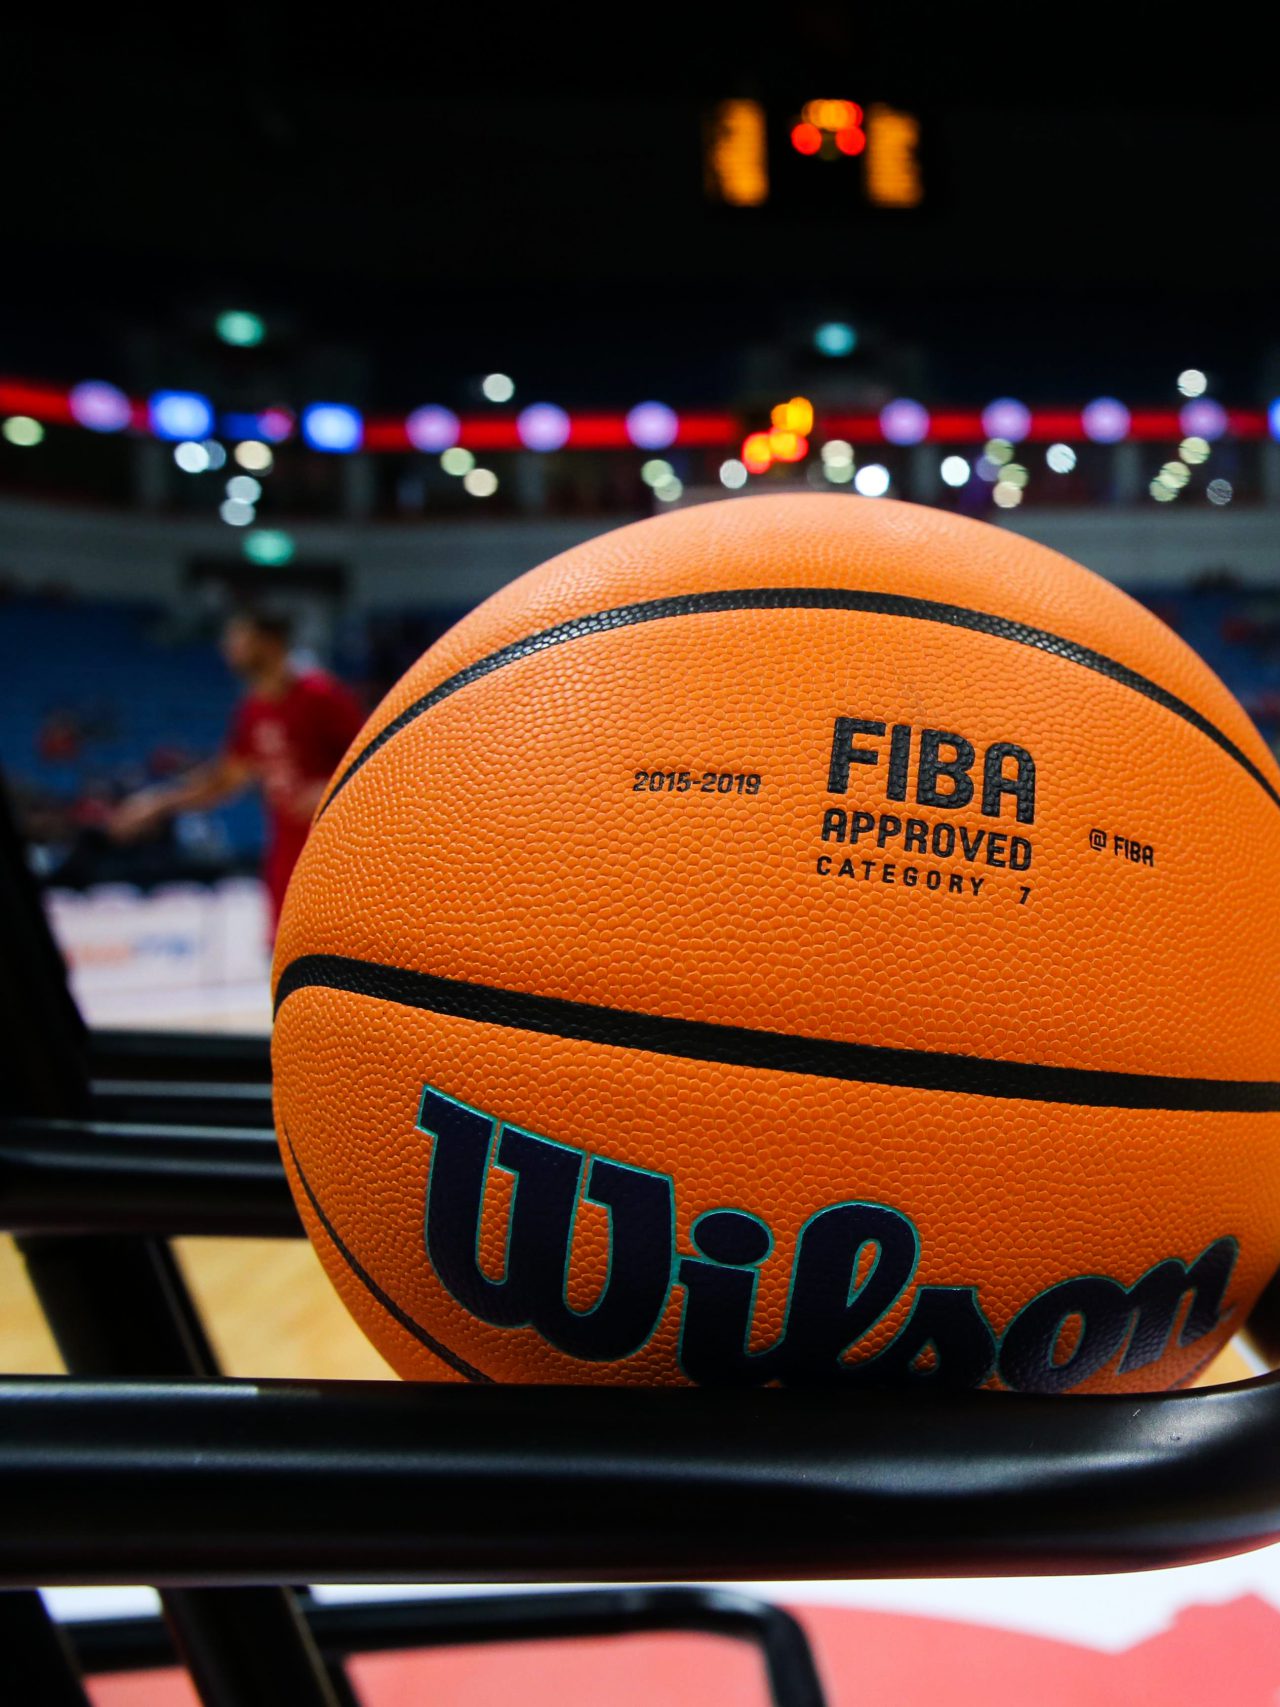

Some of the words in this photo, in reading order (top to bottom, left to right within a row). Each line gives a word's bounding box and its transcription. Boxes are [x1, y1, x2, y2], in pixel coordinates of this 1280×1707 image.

[632, 771, 762, 795] 2015-2019
[826, 716, 1036, 825] FIBA
[821, 808, 1032, 872] APPROVED
[1113, 835, 1154, 867] FIBA
[816, 855, 985, 896] CATEGORY
[1019, 886, 1032, 905] 7
[415, 1084, 1240, 1393] Wilson
